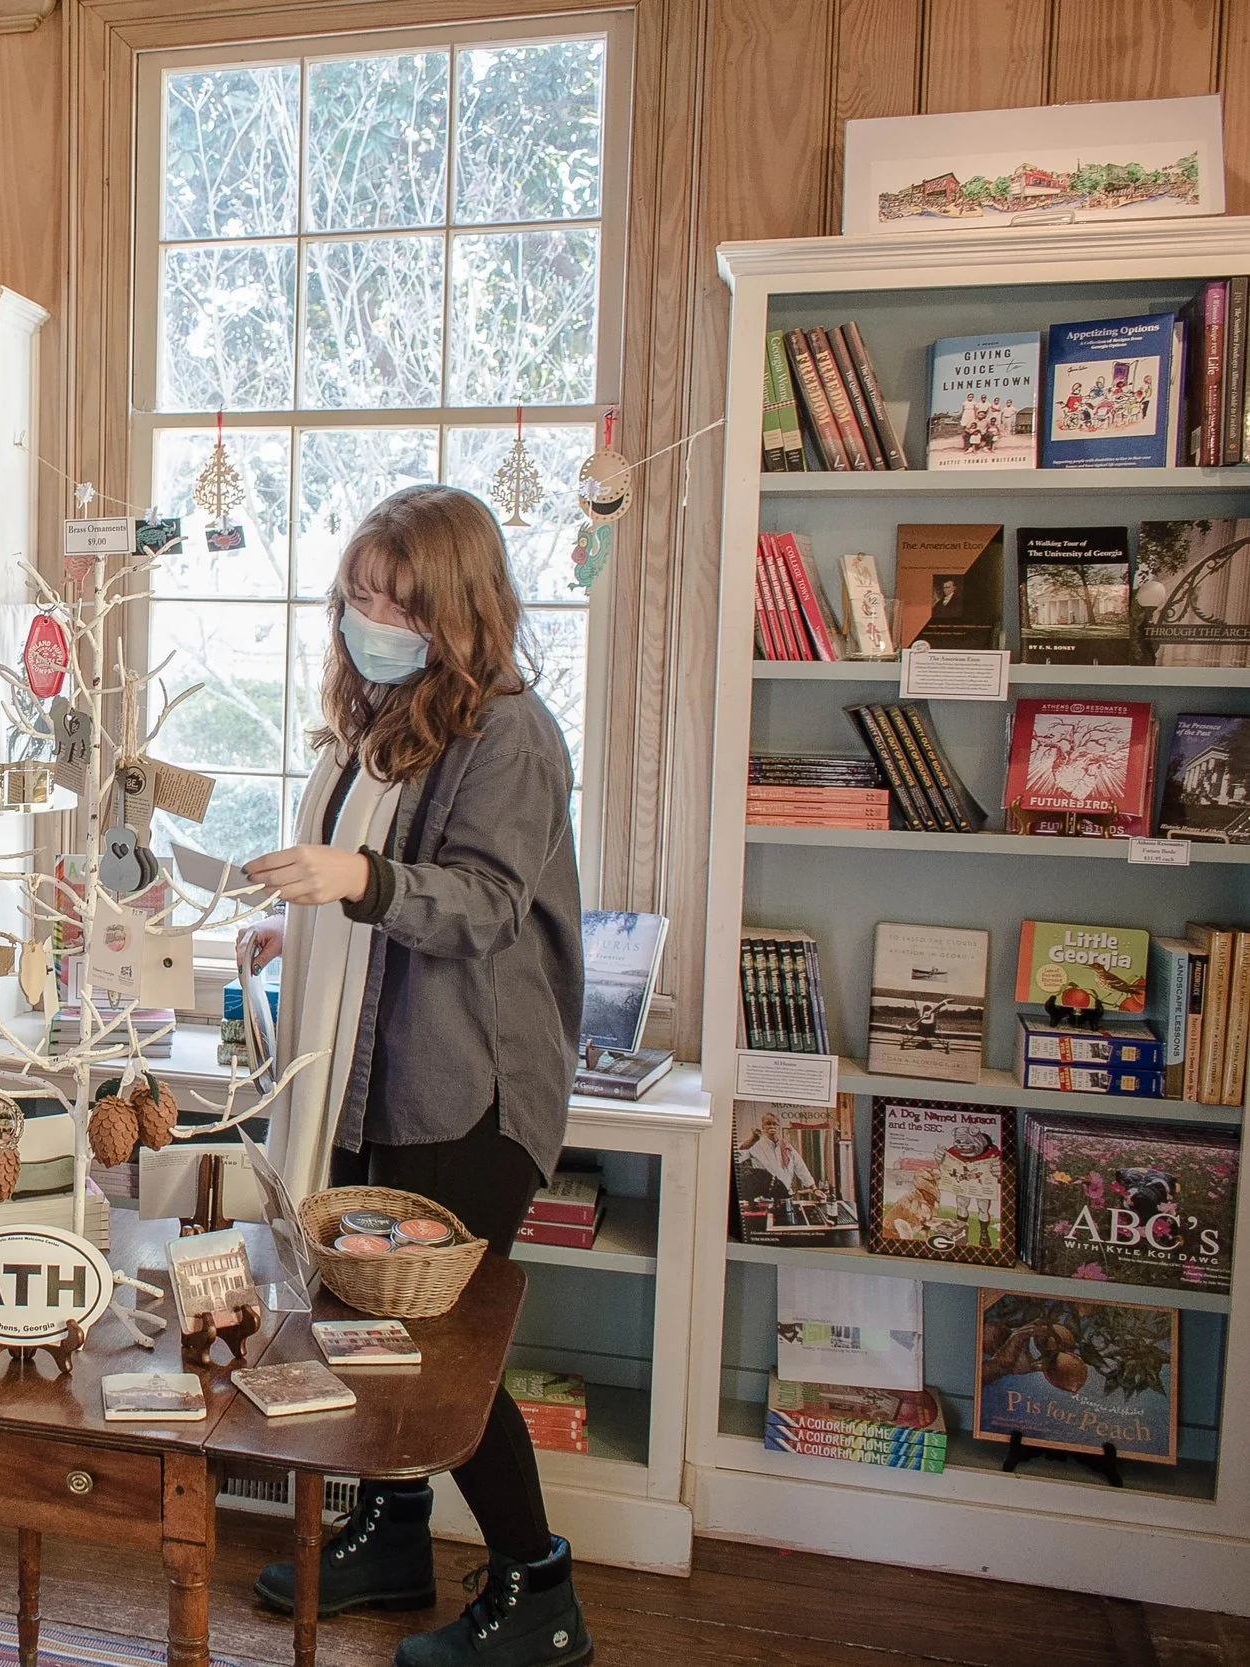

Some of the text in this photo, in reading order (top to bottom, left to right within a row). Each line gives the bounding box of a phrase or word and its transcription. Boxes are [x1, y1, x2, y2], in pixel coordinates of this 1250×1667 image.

[1066, 324, 1160, 341] Appetizing Options
[770, 336, 784, 373] Georgia
[964, 348, 1011, 361] GIVING
[955, 364, 995, 376] VOICE
[794, 351, 832, 425] FREEDOM
[814, 349, 852, 424] FREEDOM
[942, 376, 1031, 391] LINNENTOWN
[844, 370, 870, 427] The Quiet Trailblazer
[963, 457, 988, 465] THOMAS
[991, 456, 1027, 464] WHITEHEAD
[67, 524, 126, 535] Brass Ornaments
[87, 537, 107, 546] $9.00
[901, 541, 984, 550] The American Eton
[1035, 540, 1062, 548] Walking
[1027, 549, 1123, 559] The University of Georgia
[784, 544, 810, 601] COLLEGE TOWN
[1144, 627, 1250, 637] THROUGH THE ARCH
[1178, 721, 1194, 730] The
[893, 715, 931, 787] PARTY OUT OF BOUNDS
[910, 715, 948, 787] PARTY OUT OF BOUNDS
[1064, 930, 1119, 950] Little
[940, 952, 976, 960] GEORGIA
[1048, 945, 1132, 971] Georgia
[1172, 957, 1186, 1056] LANDSCAPE LESSONS
[781, 1111, 835, 1120] COOKBOOK
[888, 1109, 997, 1125] A Dog Named Munson
[888, 1121, 945, 1133] and the SEC.
[45, 1239, 60, 1247] Center
[1064, 1240, 1099, 1252] WITH
[1106, 1245, 1141, 1257] KYLE
[1178, 1253, 1219, 1265] DAWG
[23, 1321, 56, 1333] Georgia
[1006, 1390, 1023, 1412] P
[1025, 1395, 1041, 1416] is
[1045, 1401, 1079, 1424] for
[1078, 1411, 1152, 1442] Peach
[799, 1415, 891, 1439] A COLORFUL HOME
[798, 1429, 890, 1452] A COLORFUL HOME
